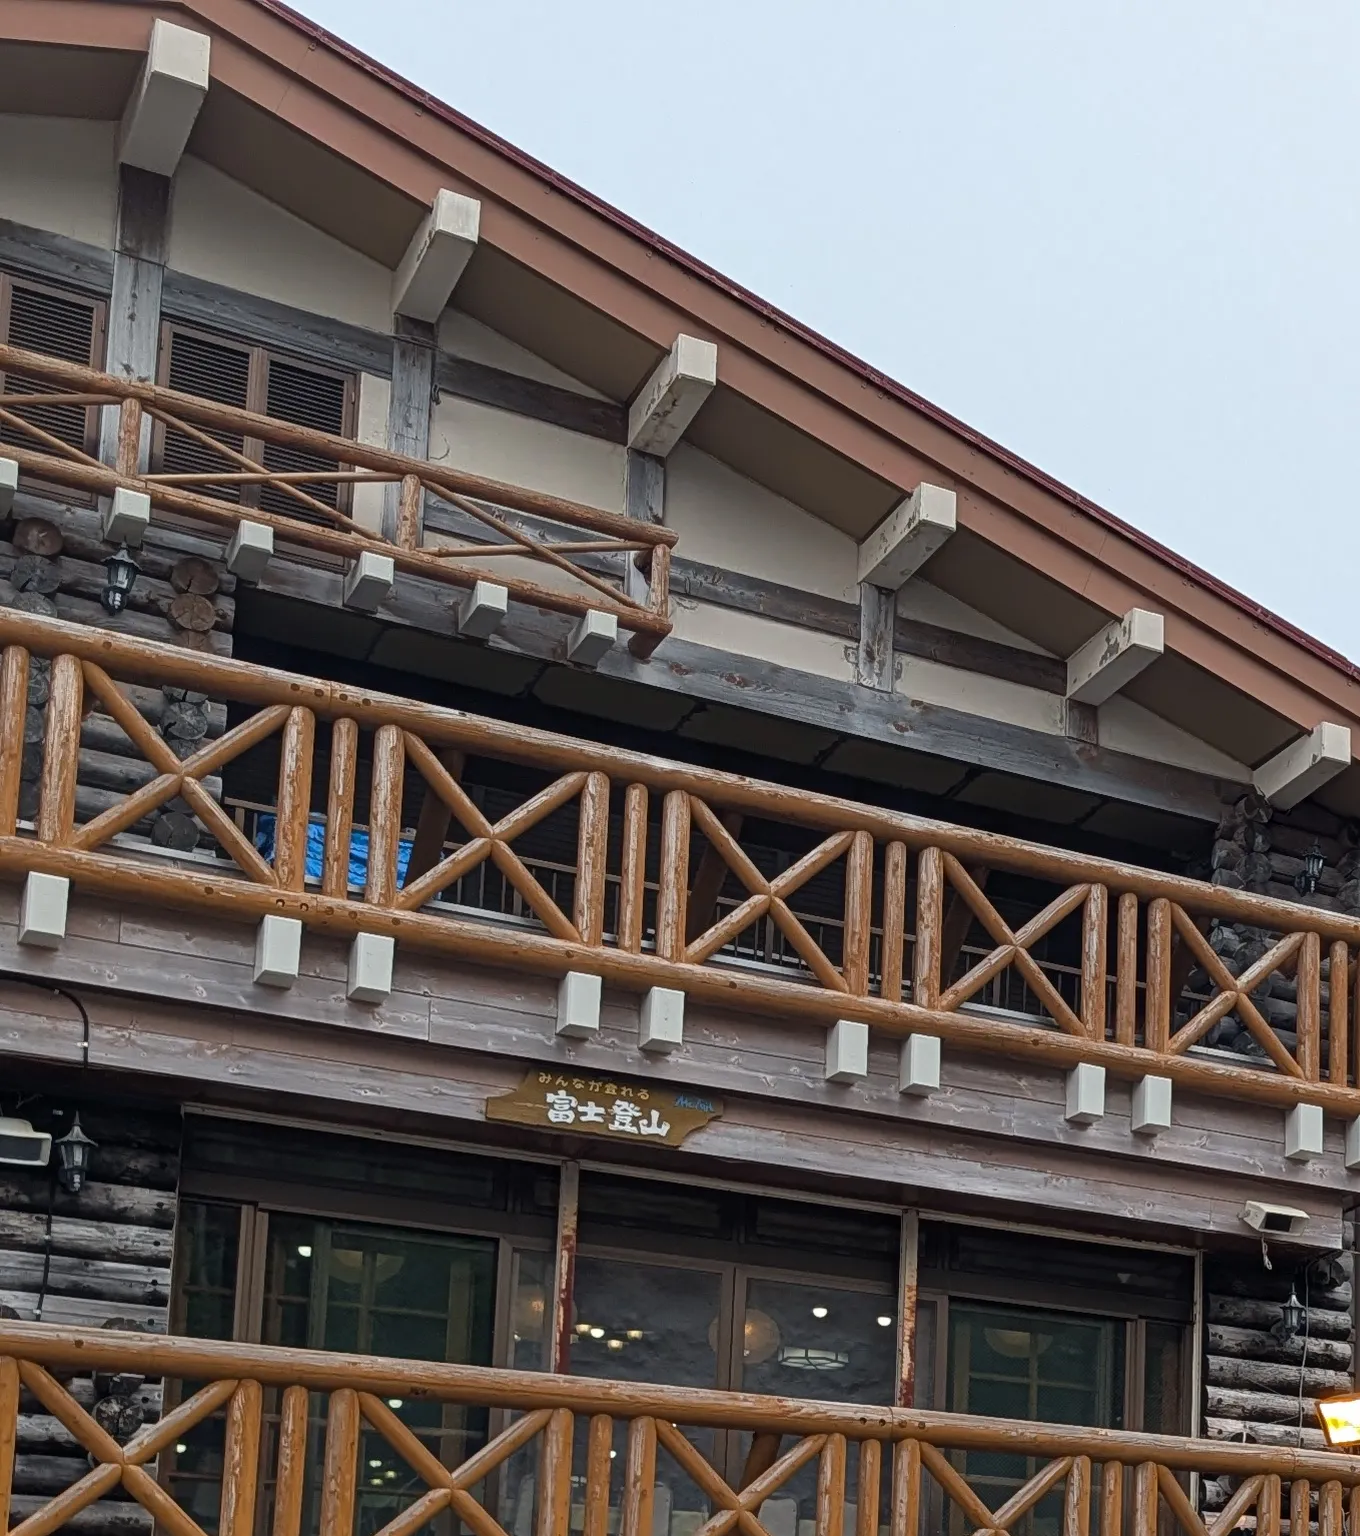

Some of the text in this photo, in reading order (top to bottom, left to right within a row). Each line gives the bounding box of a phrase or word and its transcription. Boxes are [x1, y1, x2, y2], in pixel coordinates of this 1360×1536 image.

[539, 1072, 650, 1100] みんなが登れる
[545, 1090, 671, 1137] 富士登山
